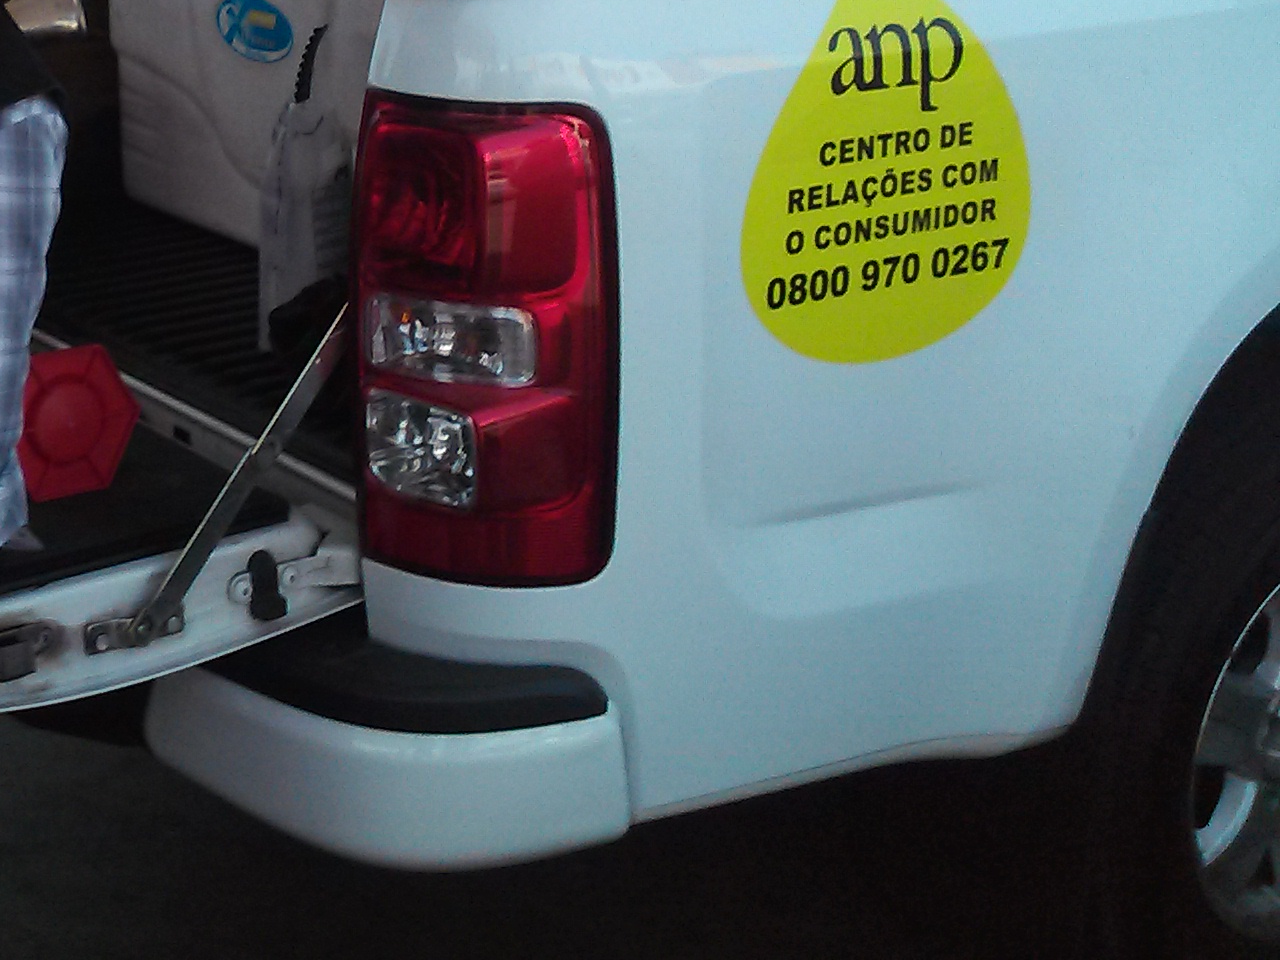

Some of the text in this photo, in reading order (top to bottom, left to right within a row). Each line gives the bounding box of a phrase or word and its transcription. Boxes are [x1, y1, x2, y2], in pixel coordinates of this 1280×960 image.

[828, 16, 964, 112] anp
[820, 121, 974, 167] CENTRO DE
[788, 158, 999, 214] RELAÇÕES COM
[785, 198, 997, 256] O CONSUMIDOR
[766, 237, 1011, 311] 0800 970 0267
